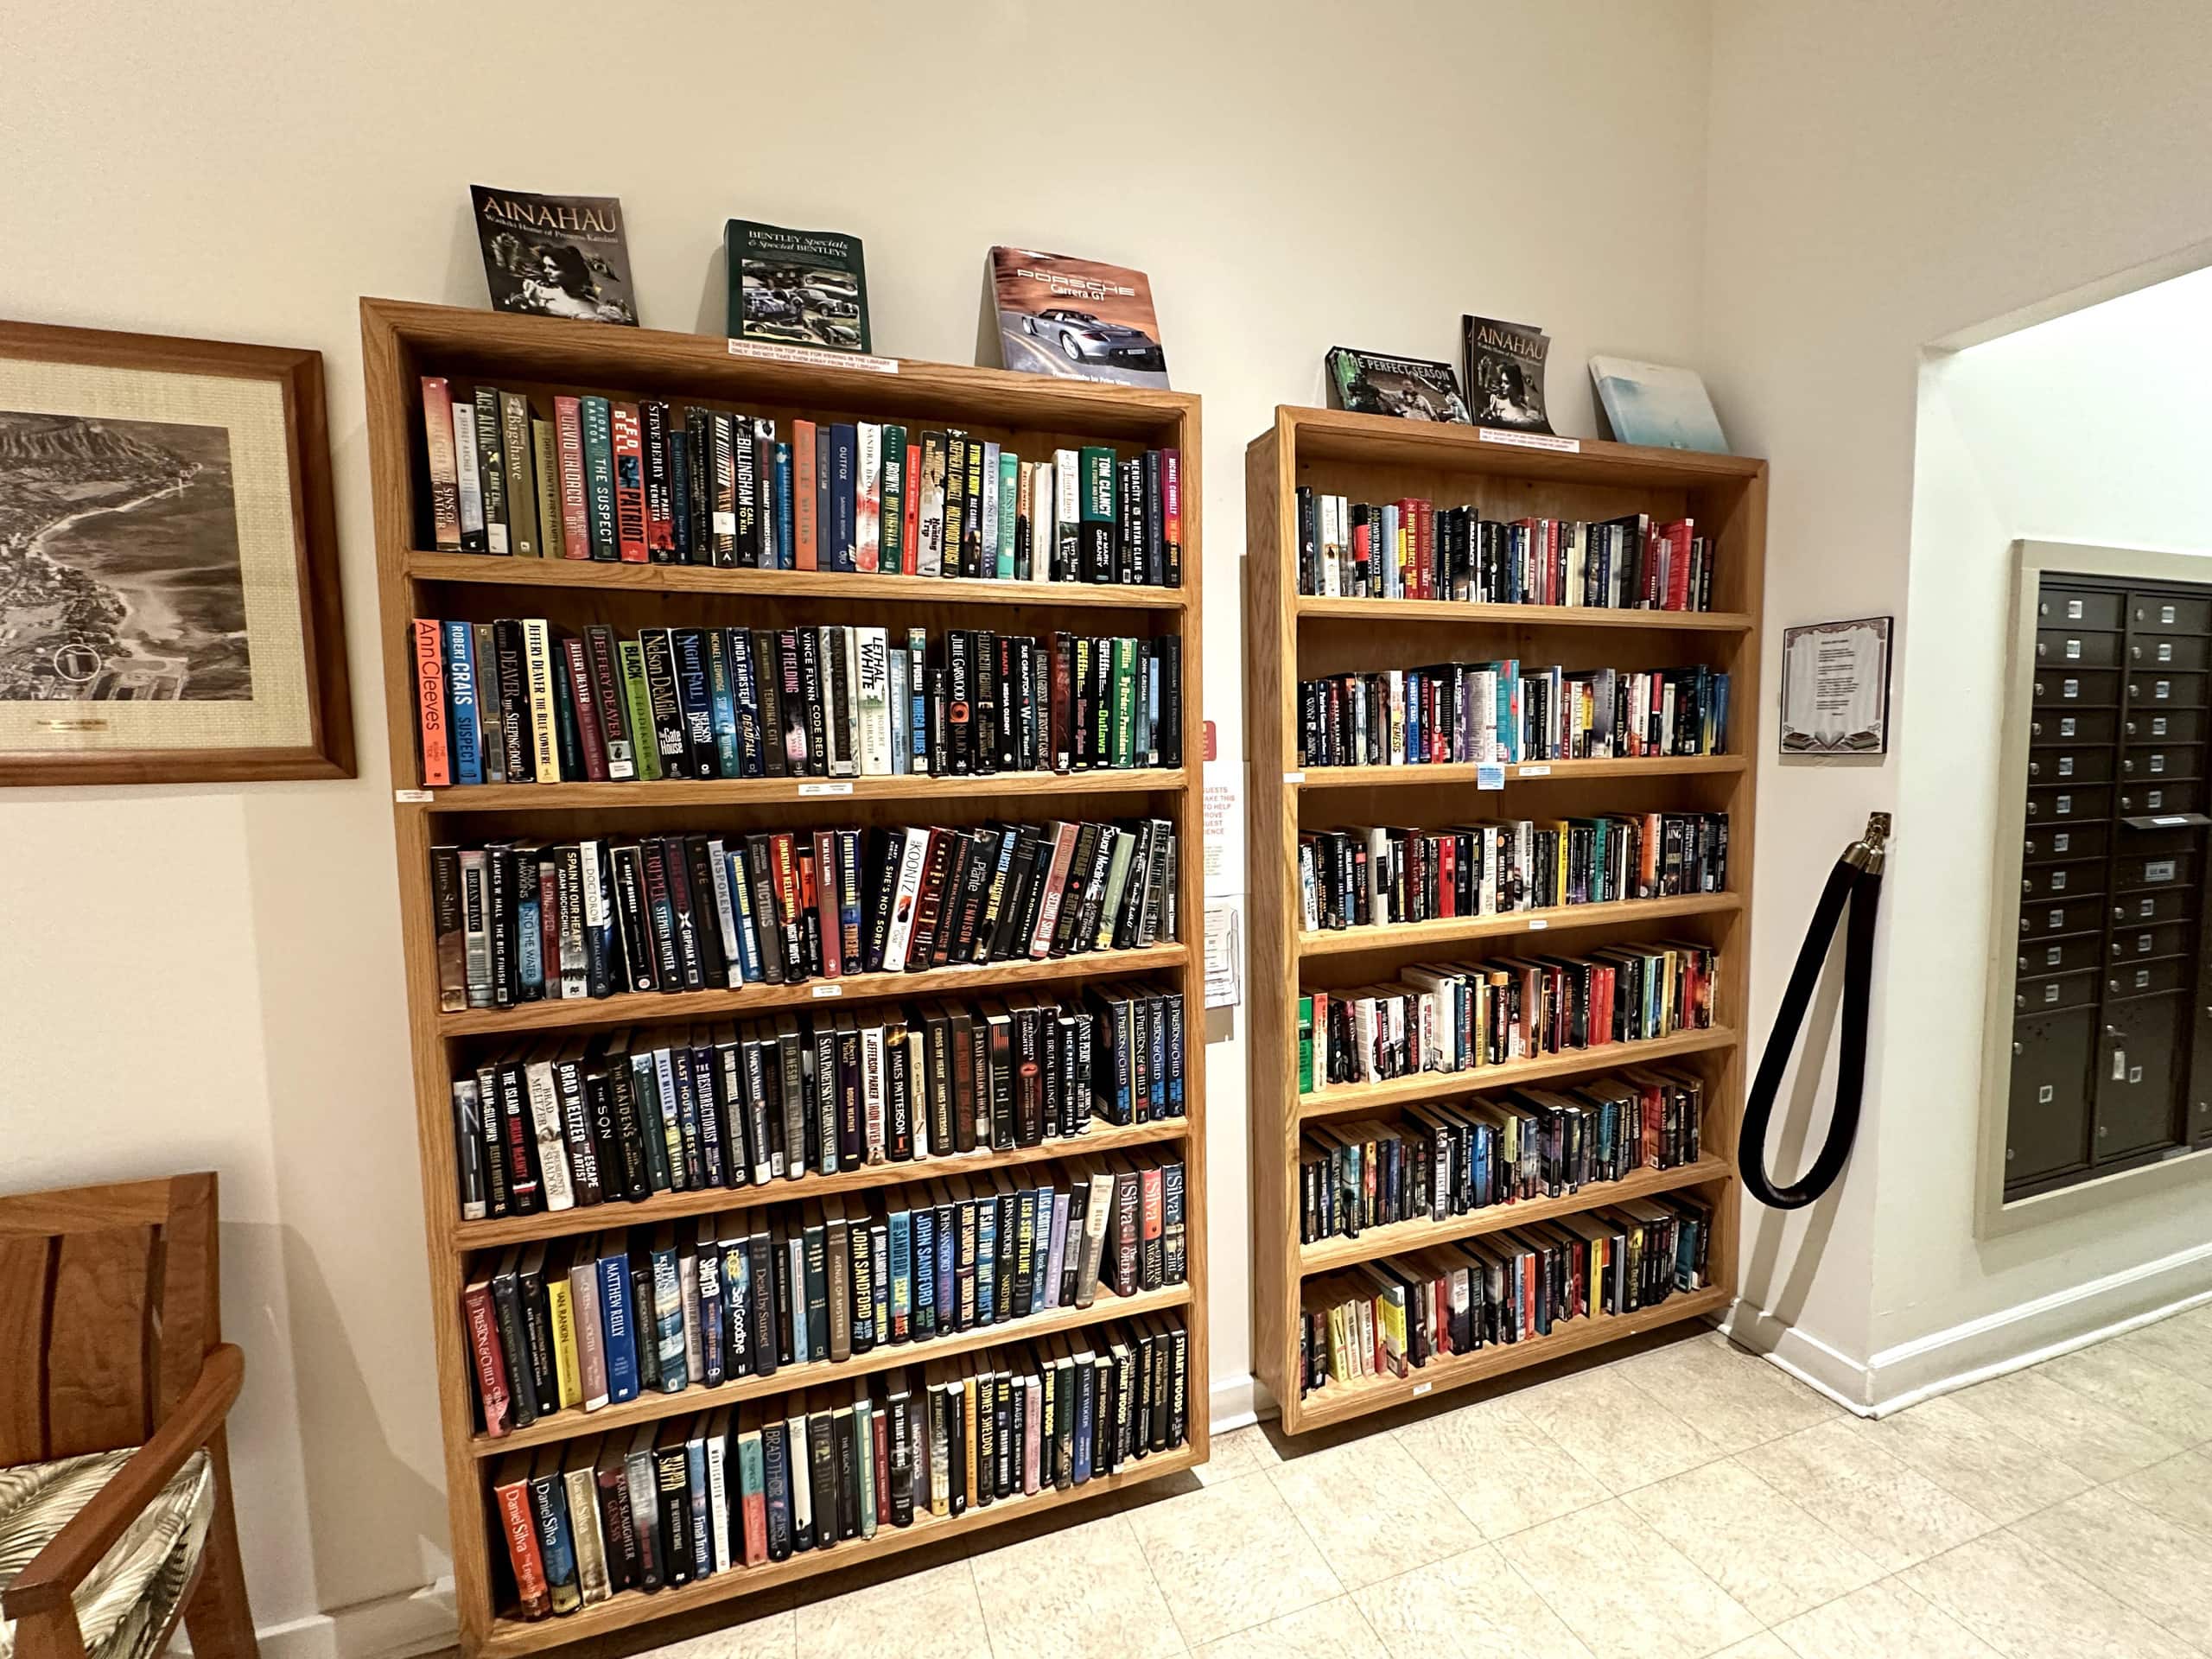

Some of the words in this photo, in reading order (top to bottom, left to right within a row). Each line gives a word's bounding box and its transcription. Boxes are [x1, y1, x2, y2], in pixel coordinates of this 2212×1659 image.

[484, 196, 616, 232] AINAHAU
[749, 231, 801, 243] BENTLEY
[804, 238, 848, 249] Specials
[760, 241, 795, 250] Special
[797, 244, 847, 257] BENTLEYS
[1018, 269, 1135, 296] PORSCHE
[1051, 283, 1090, 298] Carrera
[1092, 291, 1105, 301] GT
[1478, 326, 1544, 360] AINAHAU
[1369, 359, 1408, 374] PERFECT
[1412, 366, 1450, 380] SEASON
[588, 401, 597, 443] BARTON
[598, 407, 607, 440] FIONA
[614, 410, 628, 453] BELL
[625, 417, 639, 448] TED
[649, 404, 658, 440] STEVE
[505, 416, 524, 480] Bagshawe
[652, 442, 664, 480] BERRY
[595, 459, 607, 481] THE
[737, 437, 753, 505] BILLINGHAM
[885, 461, 899, 493] BROWNE
[1098, 457, 1111, 476] TOM
[1131, 459, 1141, 502] MENDACITY
[650, 484, 660, 522] VENDETTA
[661, 498, 670, 520] PARIS
[740, 506, 747, 517] TO
[1098, 479, 1110, 517] CLANCY
[598, 486, 612, 544] SUSPECT
[621, 491, 644, 543] PATRIOT
[1408, 513, 1416, 533] DAVID
[1103, 531, 1108, 541] BY
[1133, 520, 1141, 545] BRYAN
[1134, 547, 1142, 571] CLARK
[1408, 535, 1417, 567] BALDACCI
[419, 622, 436, 659] Ann
[452, 626, 466, 659] ROBERT
[528, 624, 543, 658] JEFFERY
[644, 634, 669, 675] Nelson
[734, 636, 745, 661] LINDA
[781, 634, 797, 650] JOY
[803, 632, 812, 664] VINCE
[624, 645, 643, 680] BLACK
[783, 652, 799, 693] FIELDING
[861, 643, 874, 690] WHITE
[873, 637, 884, 683] LETHAL
[1098, 640, 1110, 678] Griffin
[452, 663, 473, 705] CRAIS
[531, 660, 545, 694] DEAVER
[736, 664, 751, 705] FAIRSTEIN
[805, 668, 816, 701] FLYNN
[422, 661, 440, 730] Cleeves
[536, 697, 545, 711] THE
[650, 677, 677, 721] DeMille
[537, 713, 548, 729] BLUE
[812, 705, 821, 734] CODE
[1098, 709, 1109, 753] Outlaws
[458, 717, 474, 764] SUSPECT
[539, 732, 550, 765] NOWHERE
[742, 714, 756, 759] DEADFALL
[1393, 721, 1402, 753] NEMESIS
[518, 858, 527, 899] HAWKINS
[527, 865, 536, 890] PAULA
[558, 868, 568, 889] ADAM
[567, 852, 577, 880] SPAIN
[712, 849, 731, 915] UNSPOKEN
[881, 865, 893, 893] SHE'S
[900, 844, 922, 894] KOONTZ
[569, 882, 578, 892] IN
[757, 880, 773, 927] VICTIMS
[523, 907, 532, 930] INTO
[560, 891, 569, 937] HOCHSCHILD
[569, 896, 580, 914] OUR
[879, 895, 890, 915] NOT
[959, 898, 979, 944] TENNISON
[572, 917, 582, 952] HEARTS
[682, 929, 695, 958] ORPHAN
[873, 920, 884, 951] SORRY
[525, 950, 534, 980] WATER
[502, 1071, 516, 1085] THE
[559, 1065, 578, 1093] BRAD
[892, 1050, 903, 1079] JAMES
[505, 1088, 519, 1115] ISLAND
[696, 1073, 717, 1143] RESURRECTIONIST
[893, 1082, 906, 1135] PATTERSON
[564, 1096, 586, 1142] MELTZER
[573, 1154, 586, 1182] ARTIST
[584, 1155, 599, 1188] ESCAPE
[1020, 1198, 1033, 1217] LISA
[1120, 1185, 1138, 1225] Silva
[1166, 1175, 1183, 1216] Silva
[852, 1228, 868, 1258] JOHN
[916, 1216, 932, 1246] JOHN
[1019, 1220, 1033, 1274] SCOTTOLINE
[918, 1248, 933, 1306] SANDFORD
[1121, 1247, 1130, 1285] ORDER
[606, 1263, 622, 1308] MATTHEW
[729, 1287, 743, 1308] Say
[855, 1262, 872, 1319] SANDFORD
[610, 1310, 625, 1337] REILLY
[733, 1310, 747, 1354] Goodbye
[854, 1321, 864, 1339] PREY
[1176, 1337, 1185, 1374] STUART
[982, 1383, 992, 1414] SIDNEY
[1174, 1376, 1184, 1413] WOODS
[982, 1417, 993, 1456] SHELDON
[505, 1491, 521, 1524] Daniel
[537, 1484, 552, 1519] Daniel
[512, 1524, 528, 1553] Silva
[543, 1518, 558, 1546] Silva
